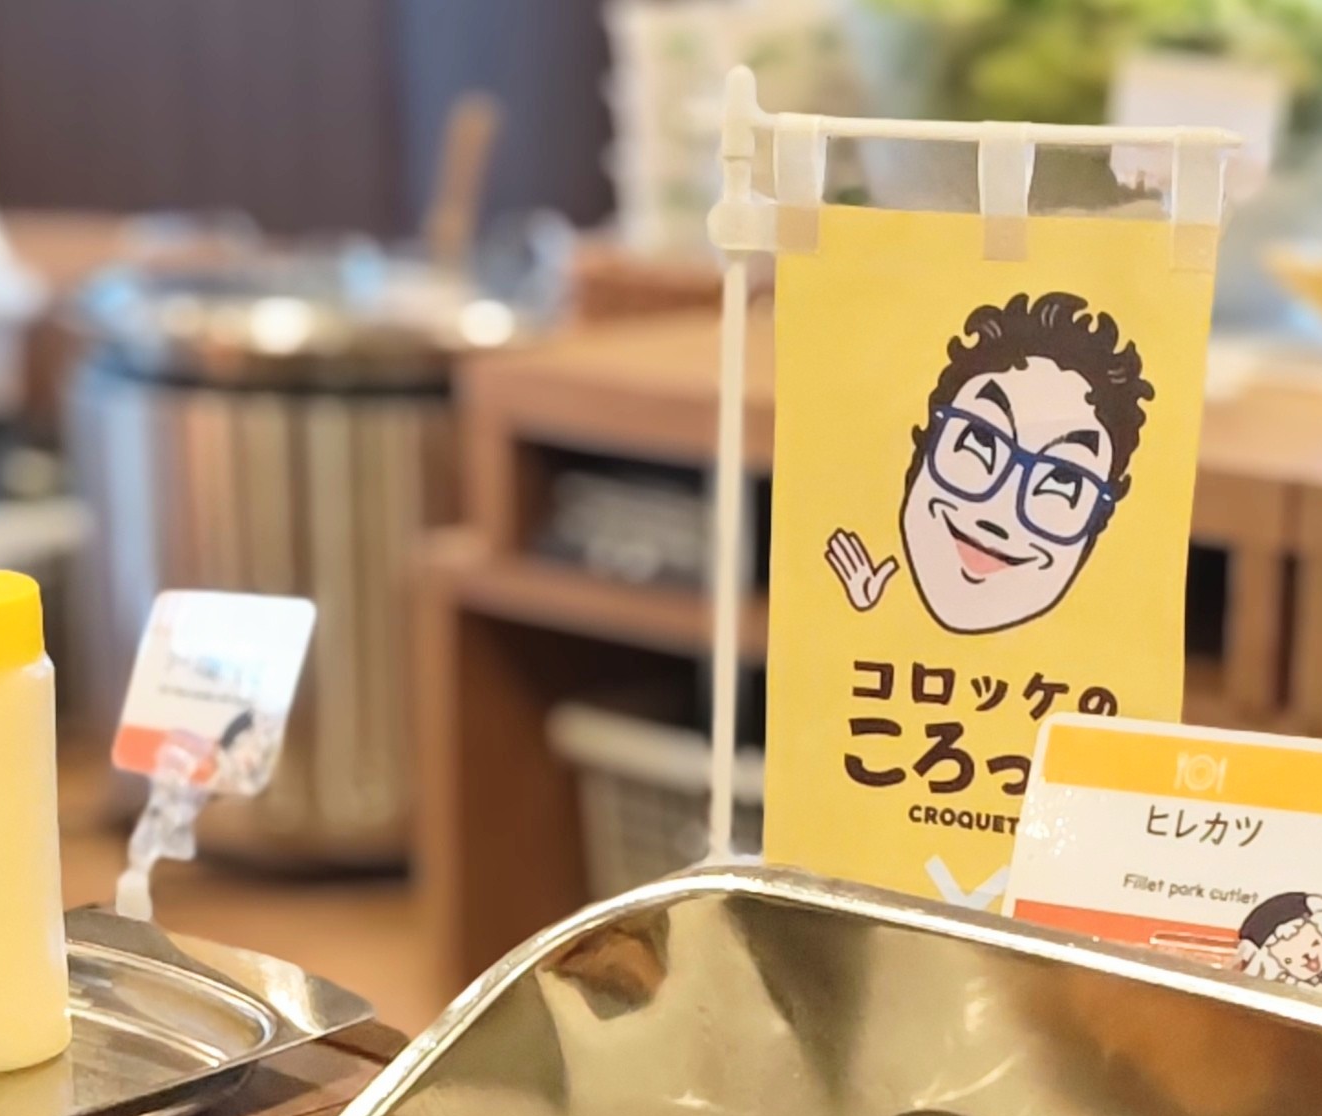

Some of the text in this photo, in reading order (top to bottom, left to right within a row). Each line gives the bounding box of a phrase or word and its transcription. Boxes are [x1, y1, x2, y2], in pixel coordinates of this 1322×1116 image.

[852, 660, 1118, 721] コロッケの
[1146, 804, 1263, 847] ヒレカツ
[1123, 873, 1259, 905] Fillet pork cutlet
